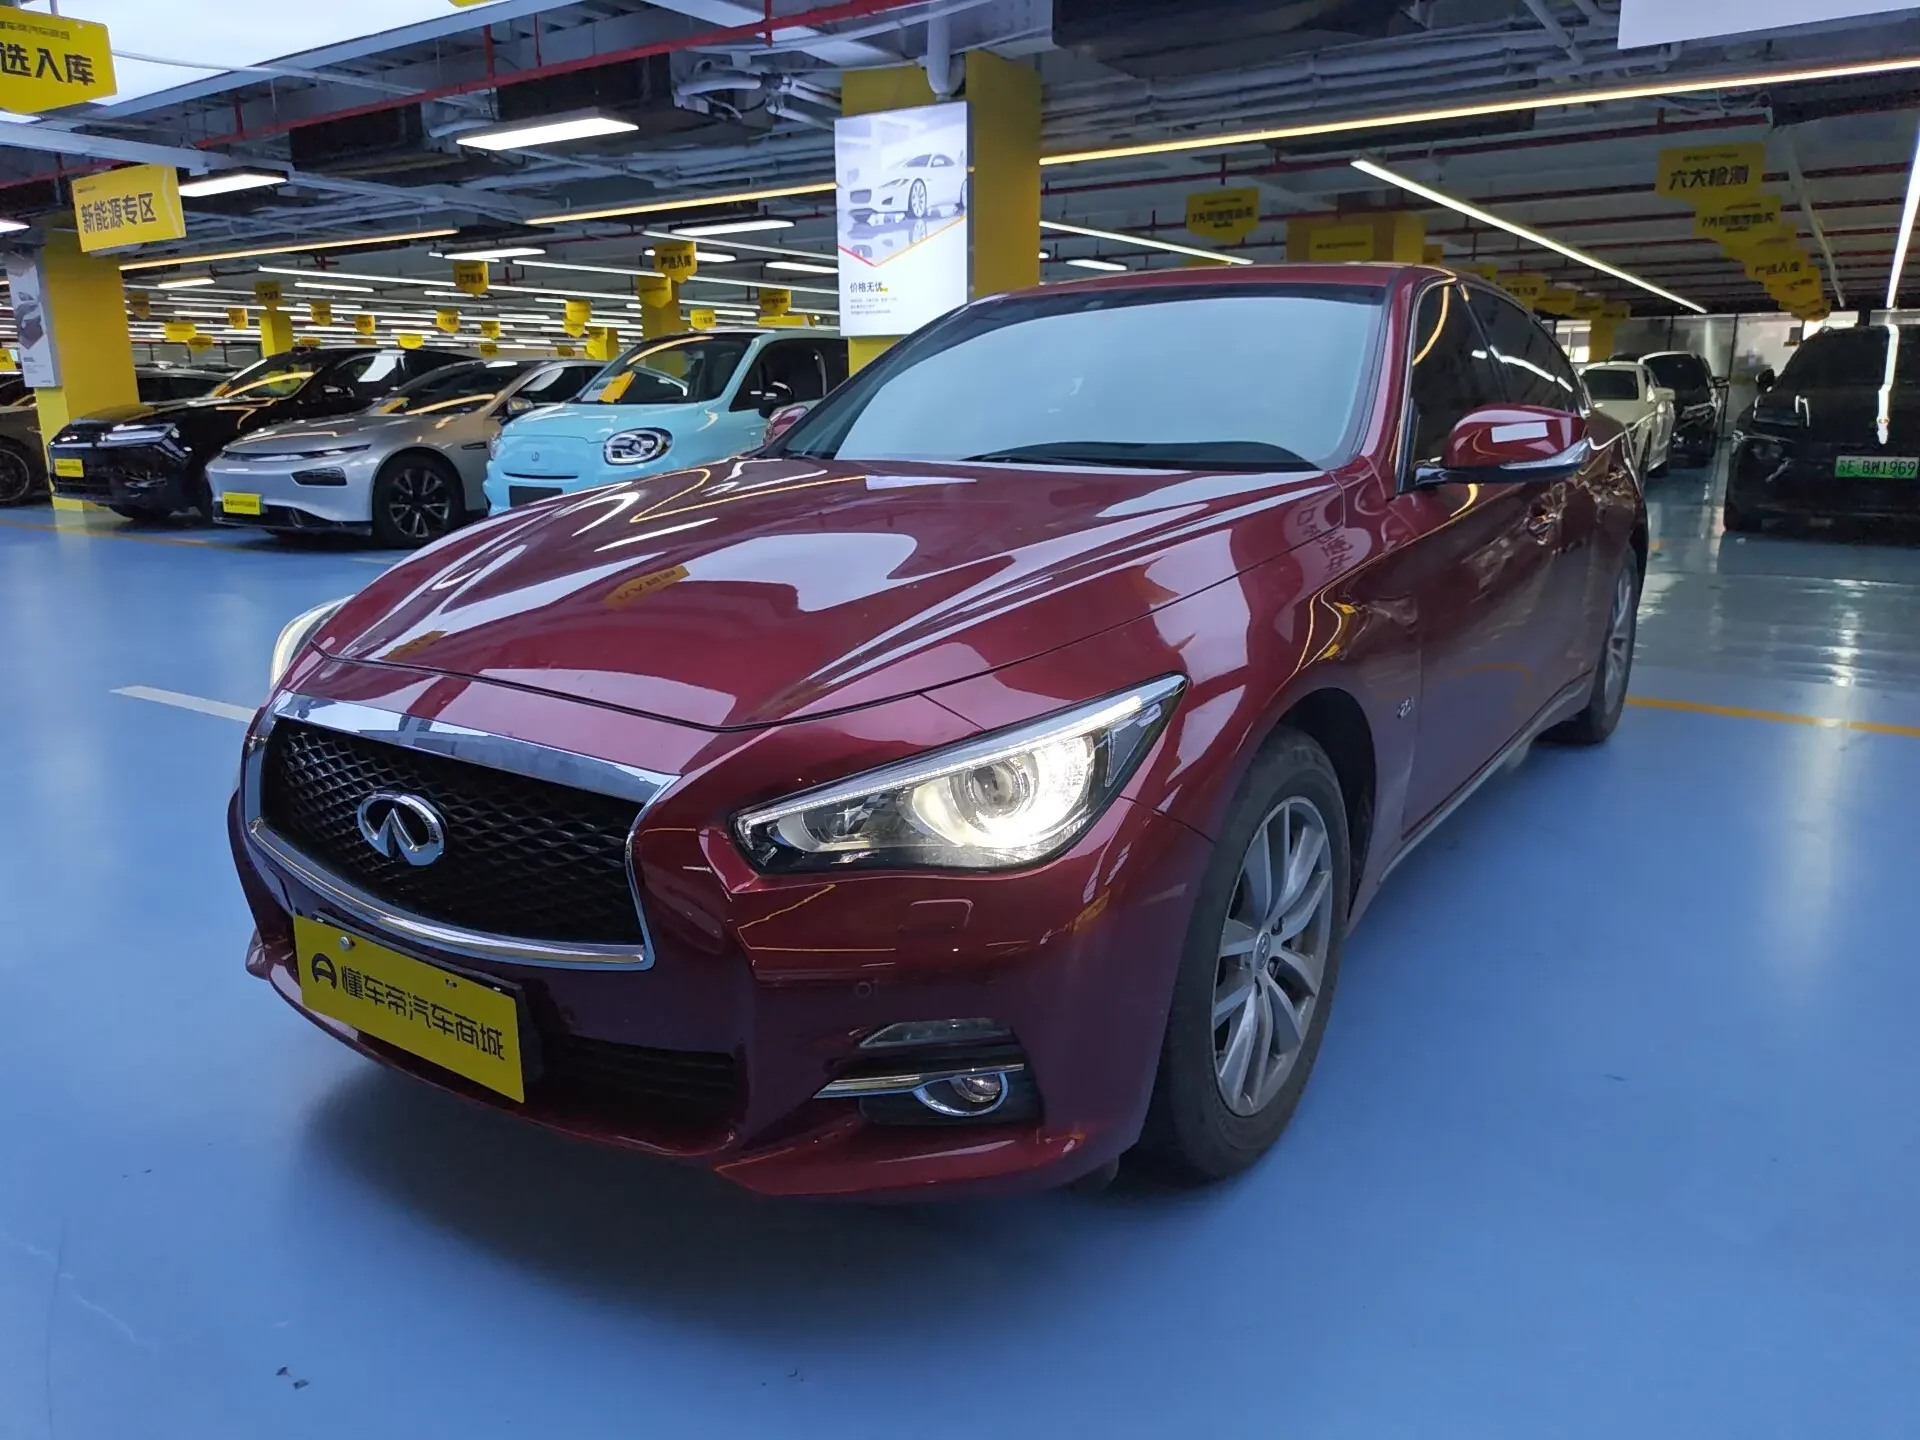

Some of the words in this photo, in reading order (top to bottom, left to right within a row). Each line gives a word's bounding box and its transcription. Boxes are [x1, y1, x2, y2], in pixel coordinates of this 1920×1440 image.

[1669, 165, 1749, 190] 六大检测
[80, 193, 157, 233] 新能源专区
[341, 965, 505, 1061] 懂车帝汽车商城
